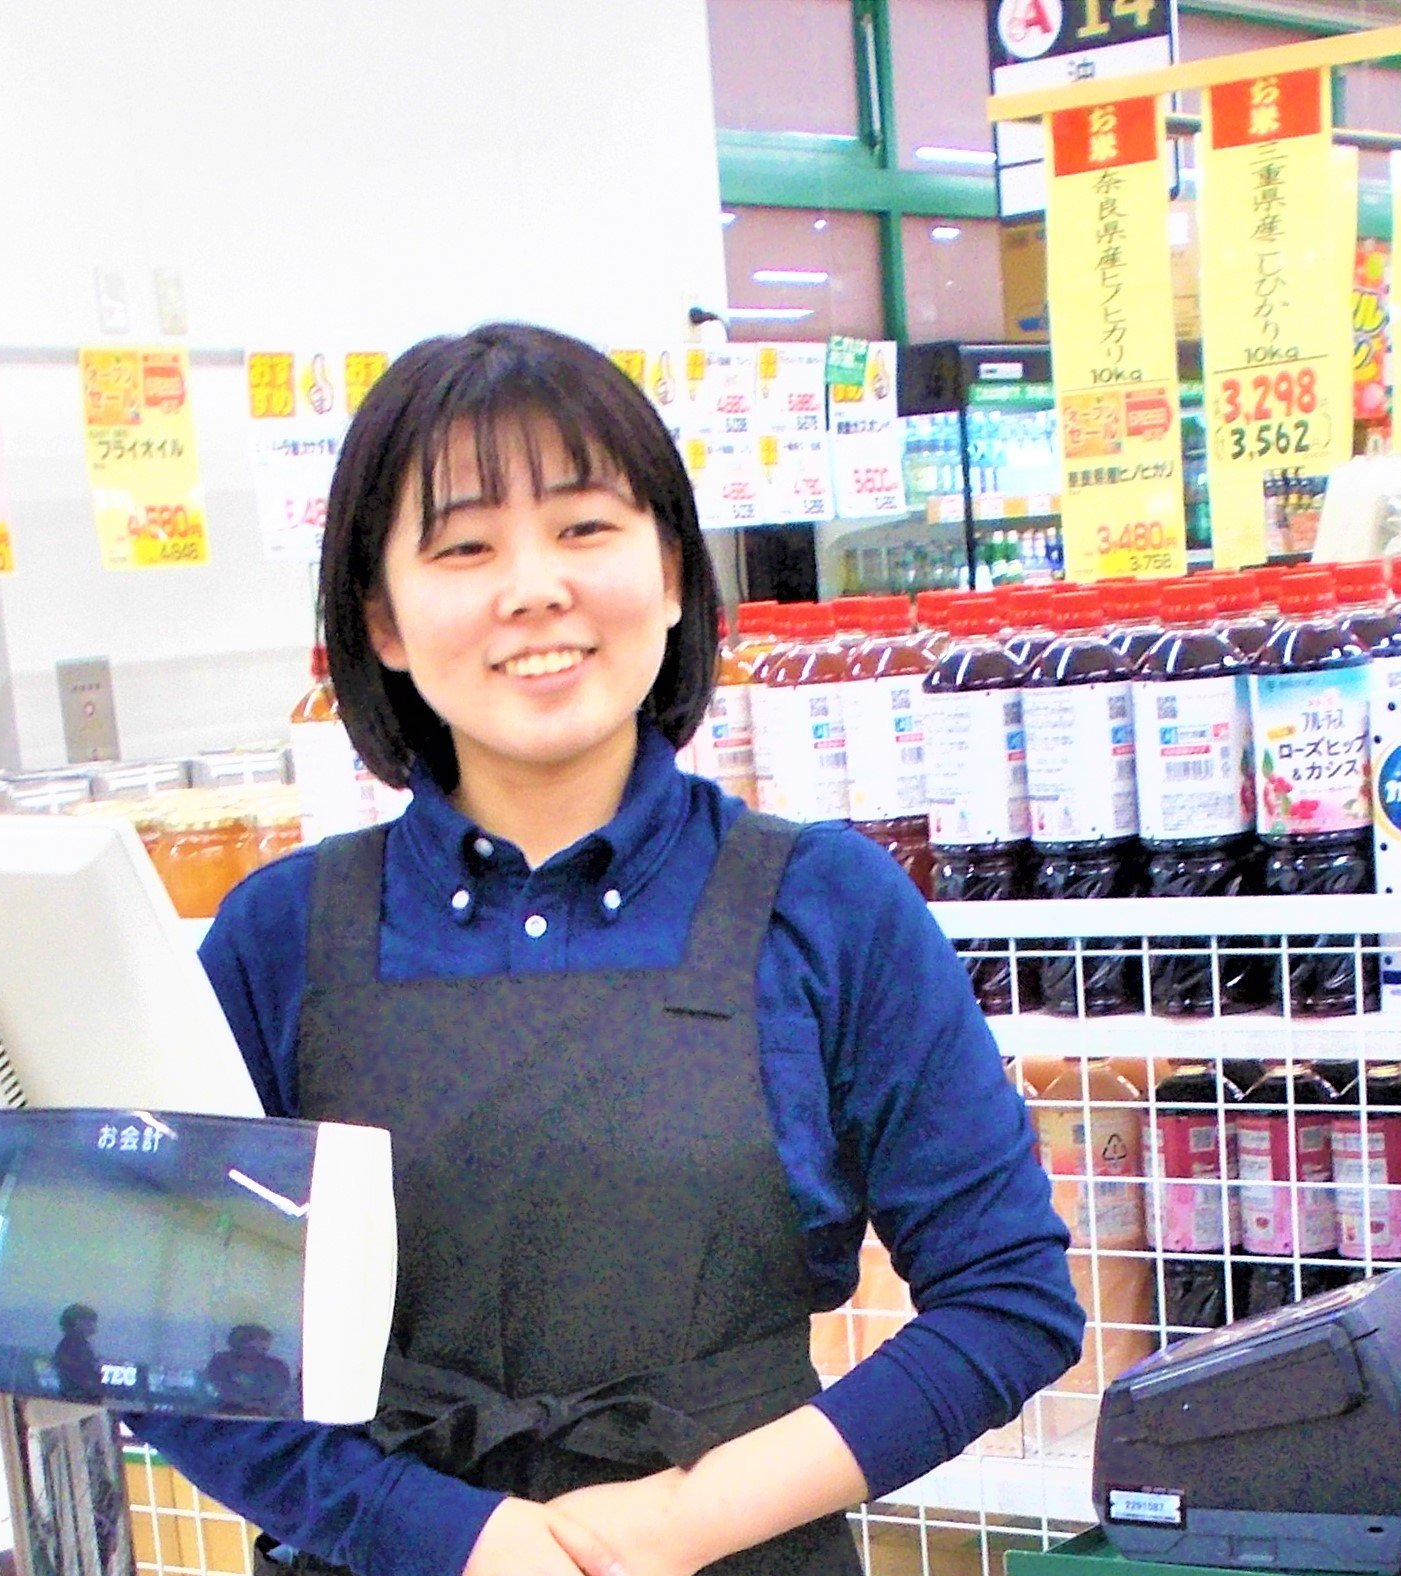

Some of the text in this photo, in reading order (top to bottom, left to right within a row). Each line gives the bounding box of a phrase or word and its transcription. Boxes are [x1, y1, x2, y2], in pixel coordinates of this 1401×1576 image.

[1076, 0, 1156, 38] 14
[1248, 77, 1282, 138] お米
[1088, 105, 1119, 164] お米
[1092, 169, 1129, 365] 奈良県産ヒノヒカリ
[1245, 346, 1300, 364] 10kg
[1091, 367, 1143, 385] 10kg
[1221, 366, 1318, 425] 3,298
[99, 440, 185, 460] フライオイル
[1230, 419, 1311, 461] 3,562
[97, 1123, 164, 1153] お会計
